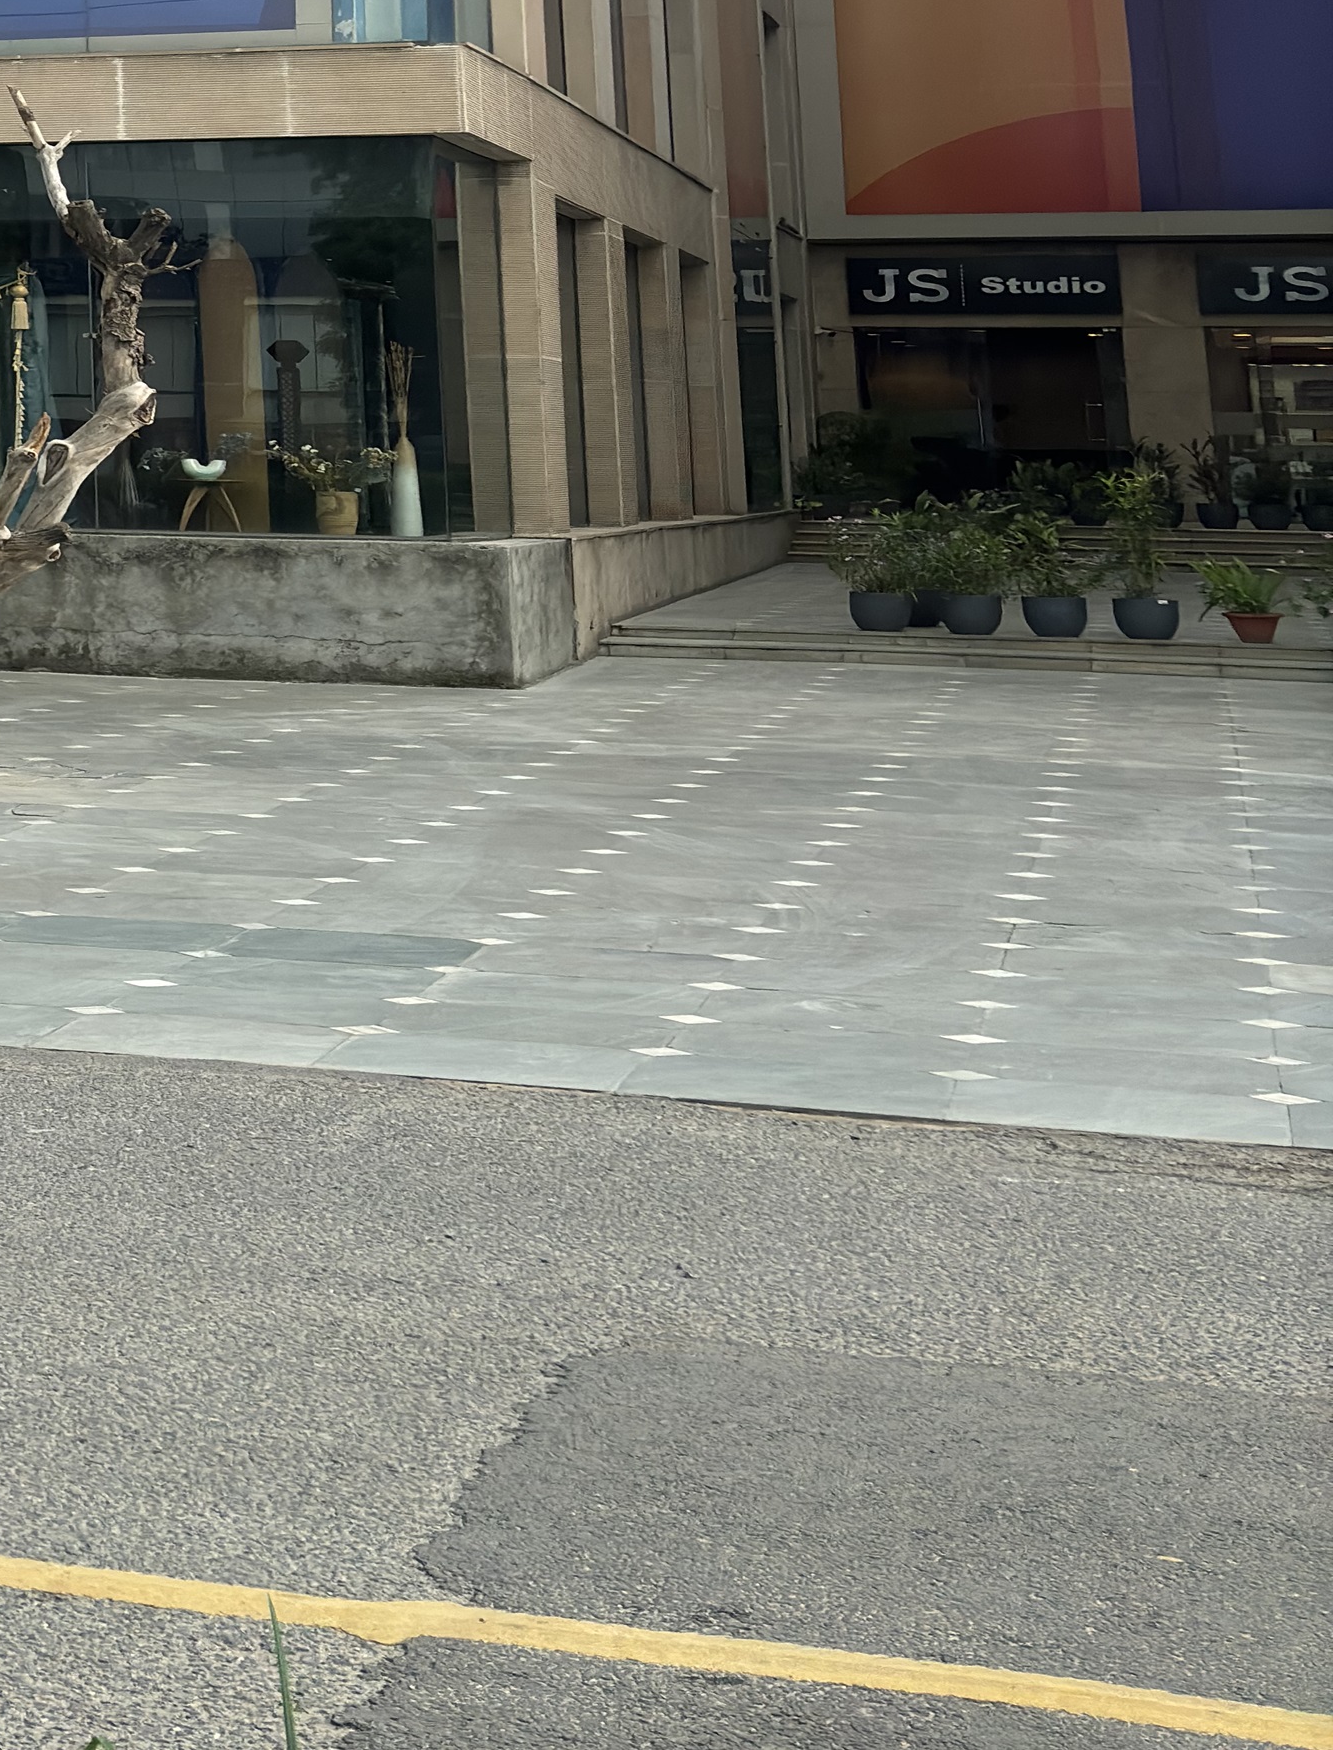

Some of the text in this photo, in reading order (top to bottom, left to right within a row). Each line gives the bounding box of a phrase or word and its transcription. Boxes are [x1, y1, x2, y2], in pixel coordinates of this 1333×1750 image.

[863, 268, 1106, 303] JS Studio
[1234, 266, 1330, 302] JS
